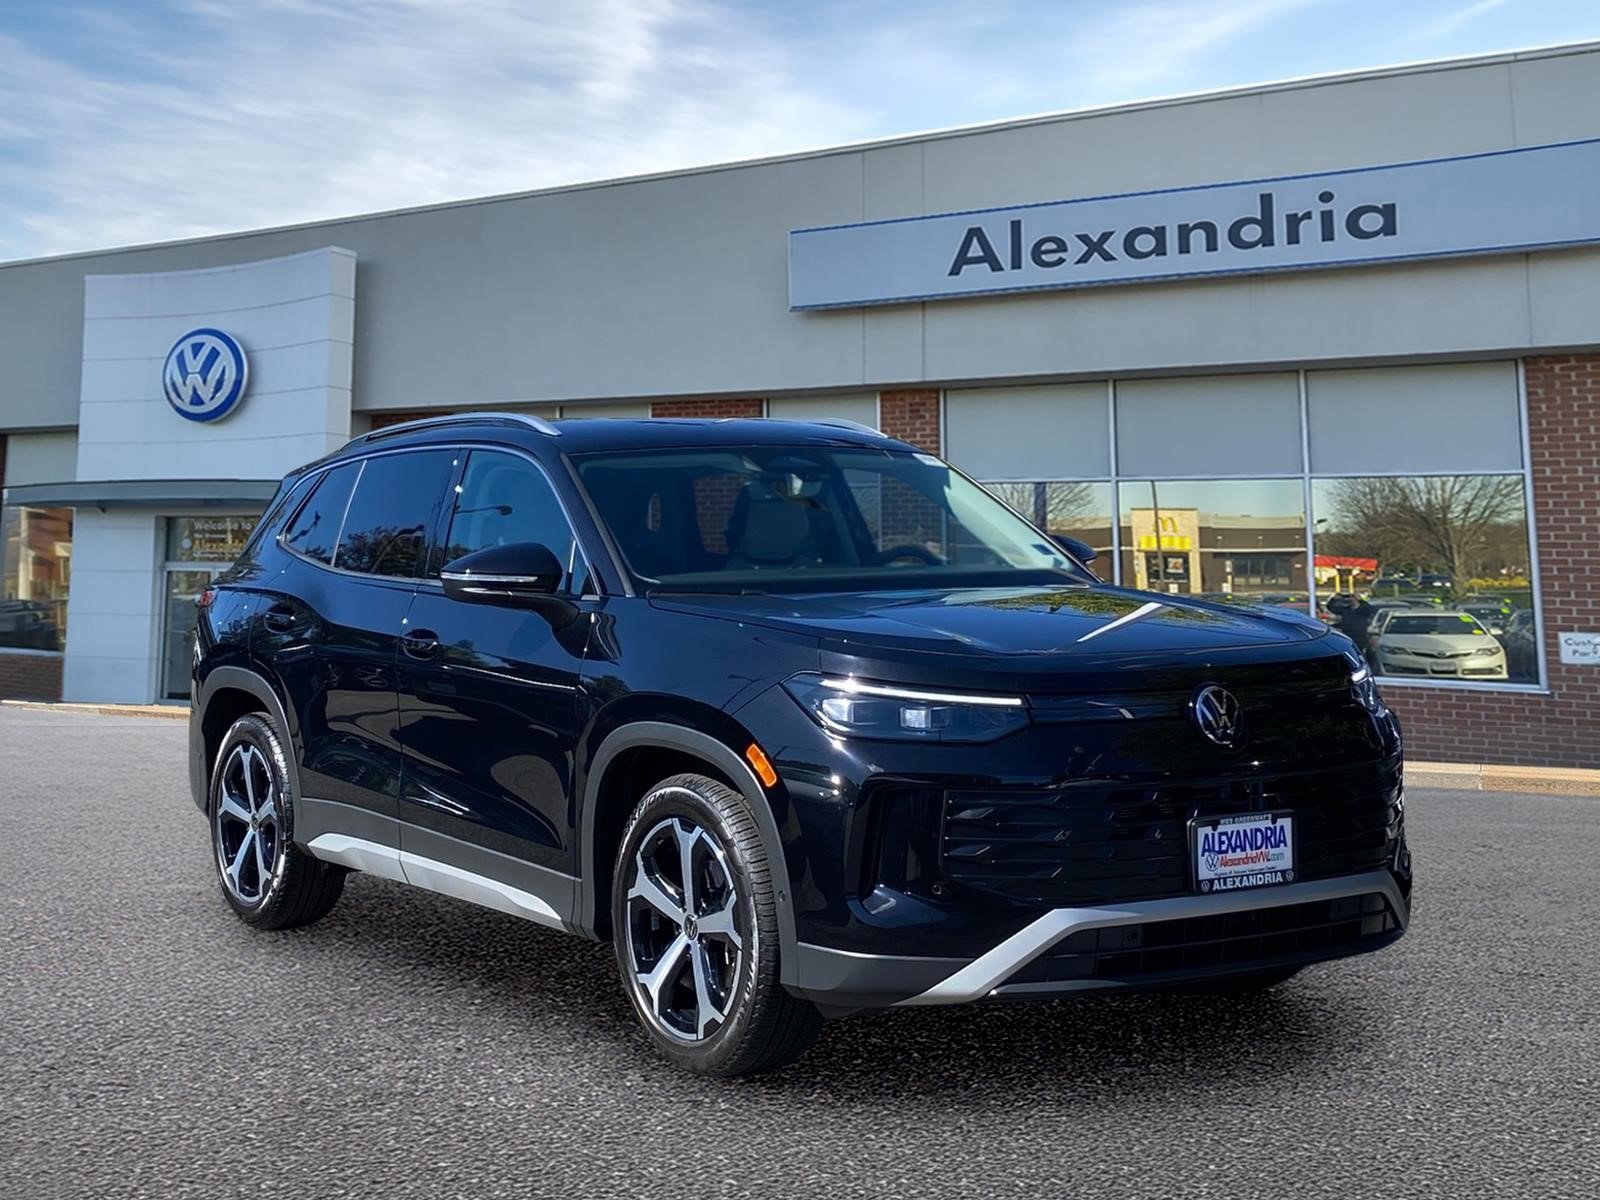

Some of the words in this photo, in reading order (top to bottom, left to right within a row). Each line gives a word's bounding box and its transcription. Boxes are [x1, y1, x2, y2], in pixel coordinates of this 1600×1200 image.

[947, 190, 1398, 277] Alexandria
[164, 334, 237, 413] VW
[1201, 825, 1288, 857] ALEXANDRIA
[1212, 872, 1284, 891] ALEXANDRIA
